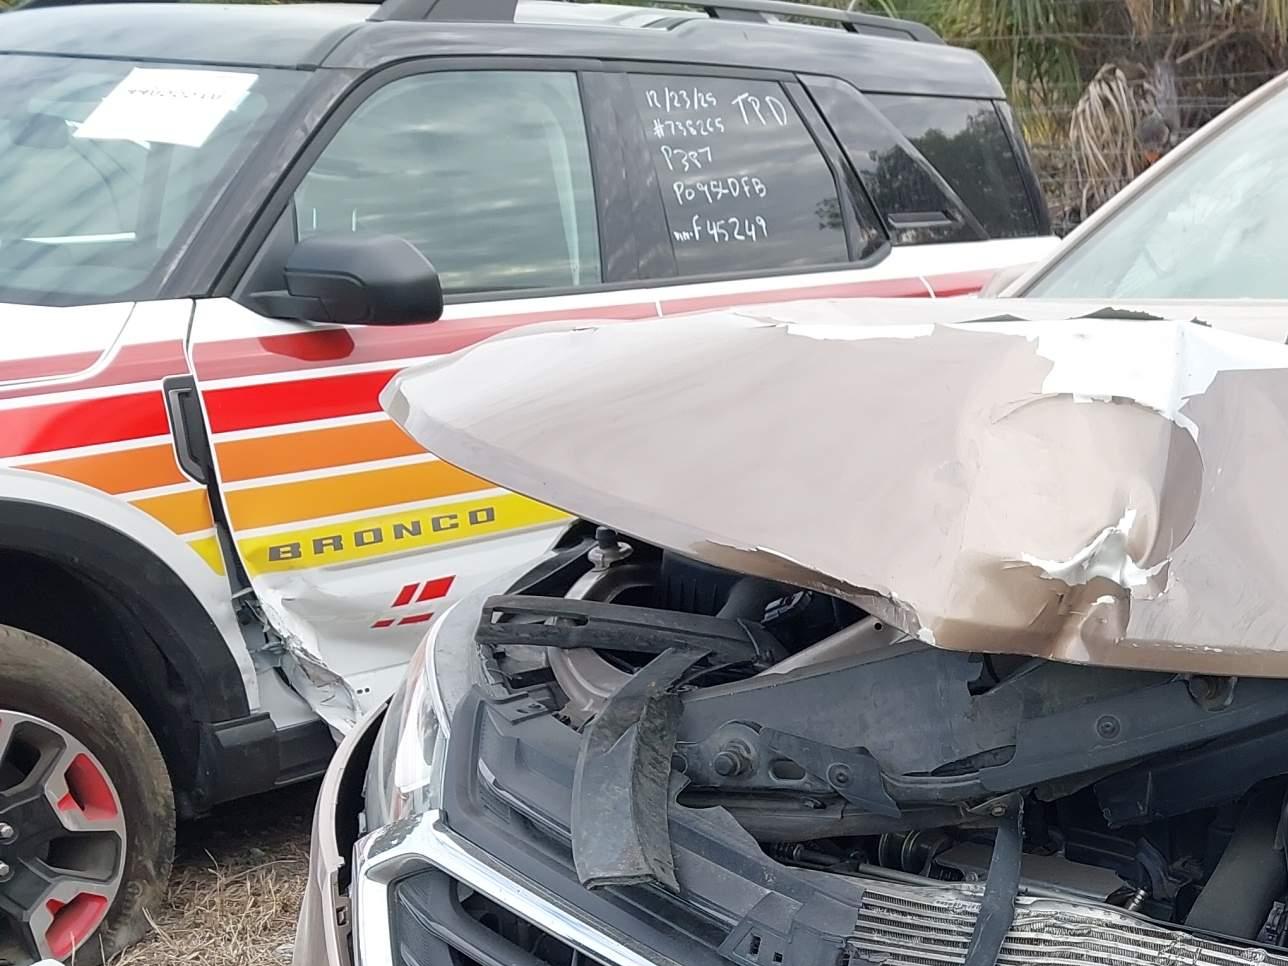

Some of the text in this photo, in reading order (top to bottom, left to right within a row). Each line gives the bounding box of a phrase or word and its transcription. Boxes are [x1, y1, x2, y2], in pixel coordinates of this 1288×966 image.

[645, 87, 717, 112] 12/23/25
[731, 92, 788, 126] TPD
[268, 507, 495, 562] BRONCO
